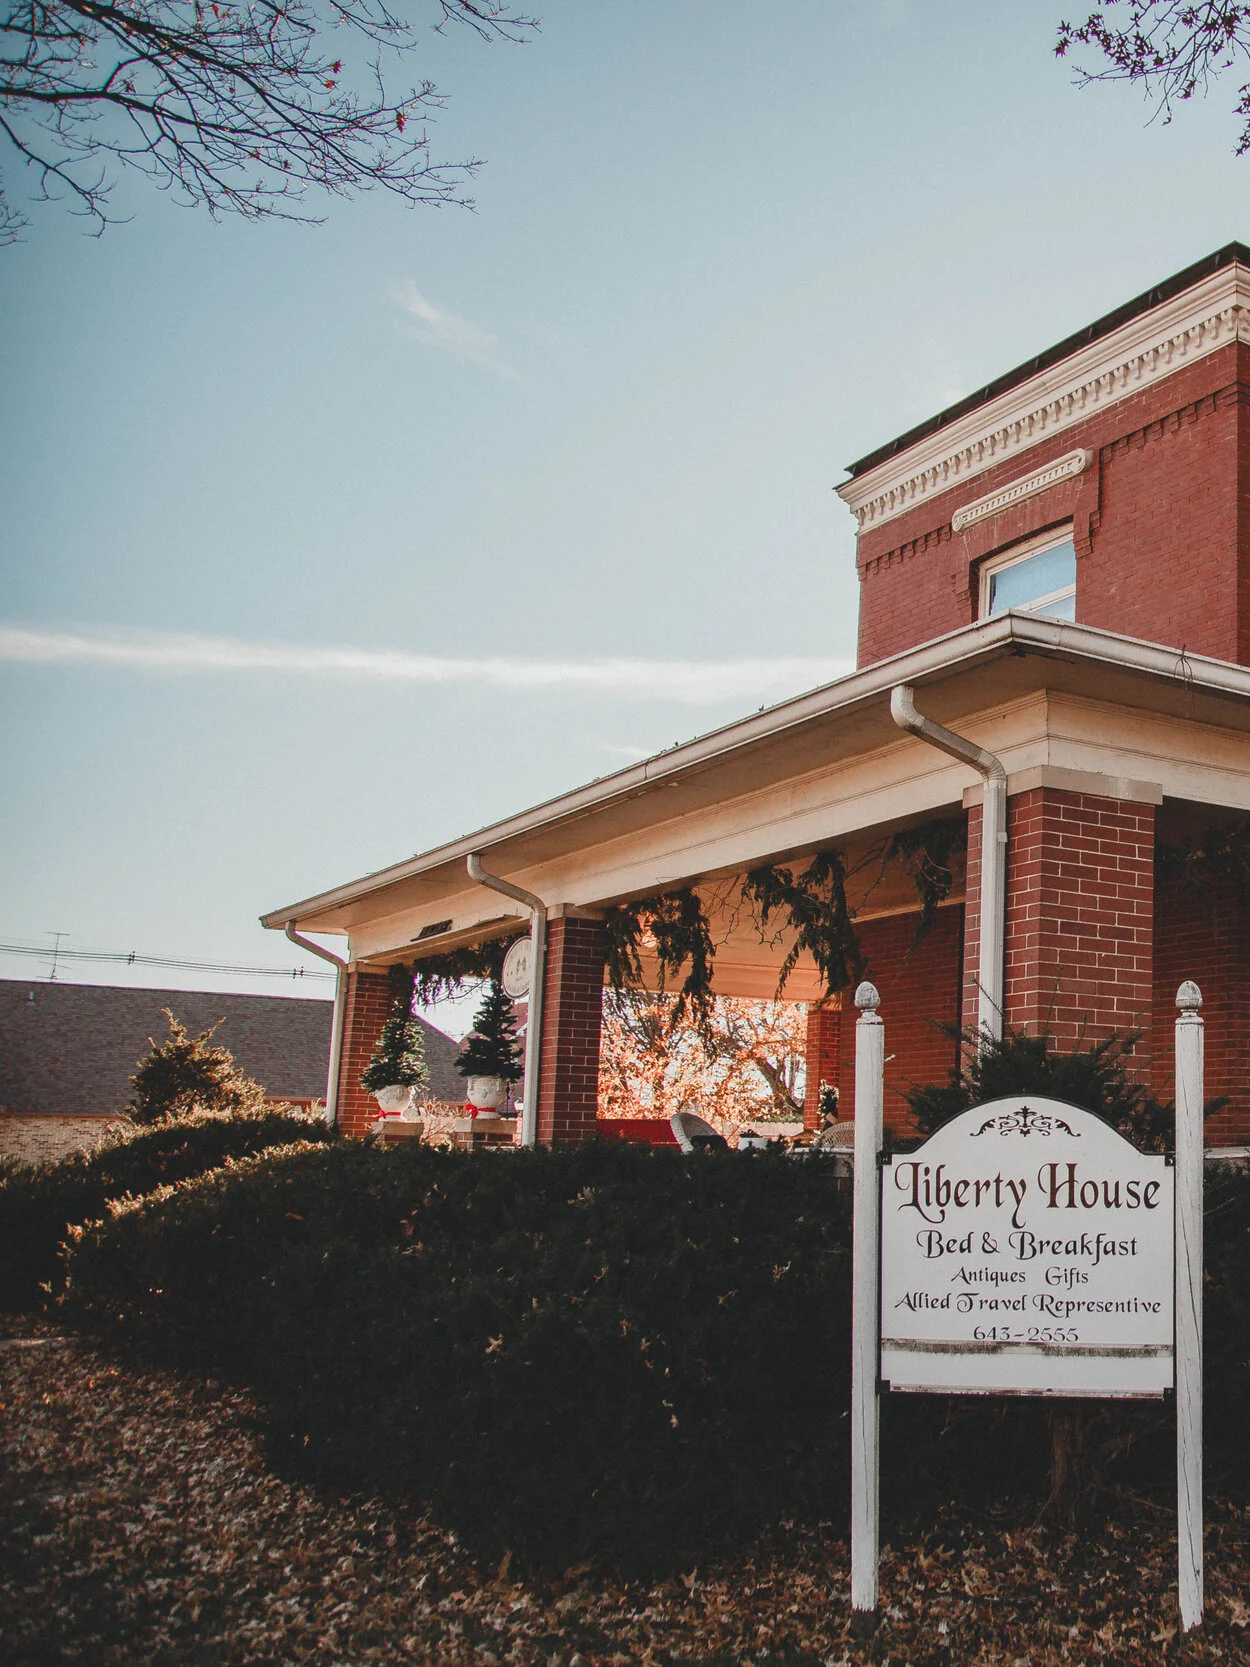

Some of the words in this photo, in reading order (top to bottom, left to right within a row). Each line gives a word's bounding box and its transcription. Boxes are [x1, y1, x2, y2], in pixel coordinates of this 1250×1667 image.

[894, 1161, 1027, 1229] Liberty
[1037, 1162, 1161, 1209] House
[916, 1229, 975, 1259] Bed
[981, 1231, 1001, 1254] &
[1008, 1231, 1138, 1266] Breakfast
[951, 1266, 1026, 1288] Antiques
[1045, 1266, 1089, 1290] Gifts
[894, 1292, 952, 1312] Allied
[956, 1292, 1028, 1313] Travel
[1032, 1294, 1162, 1319] Representive
[973, 1326, 1079, 1343] 643-2555
